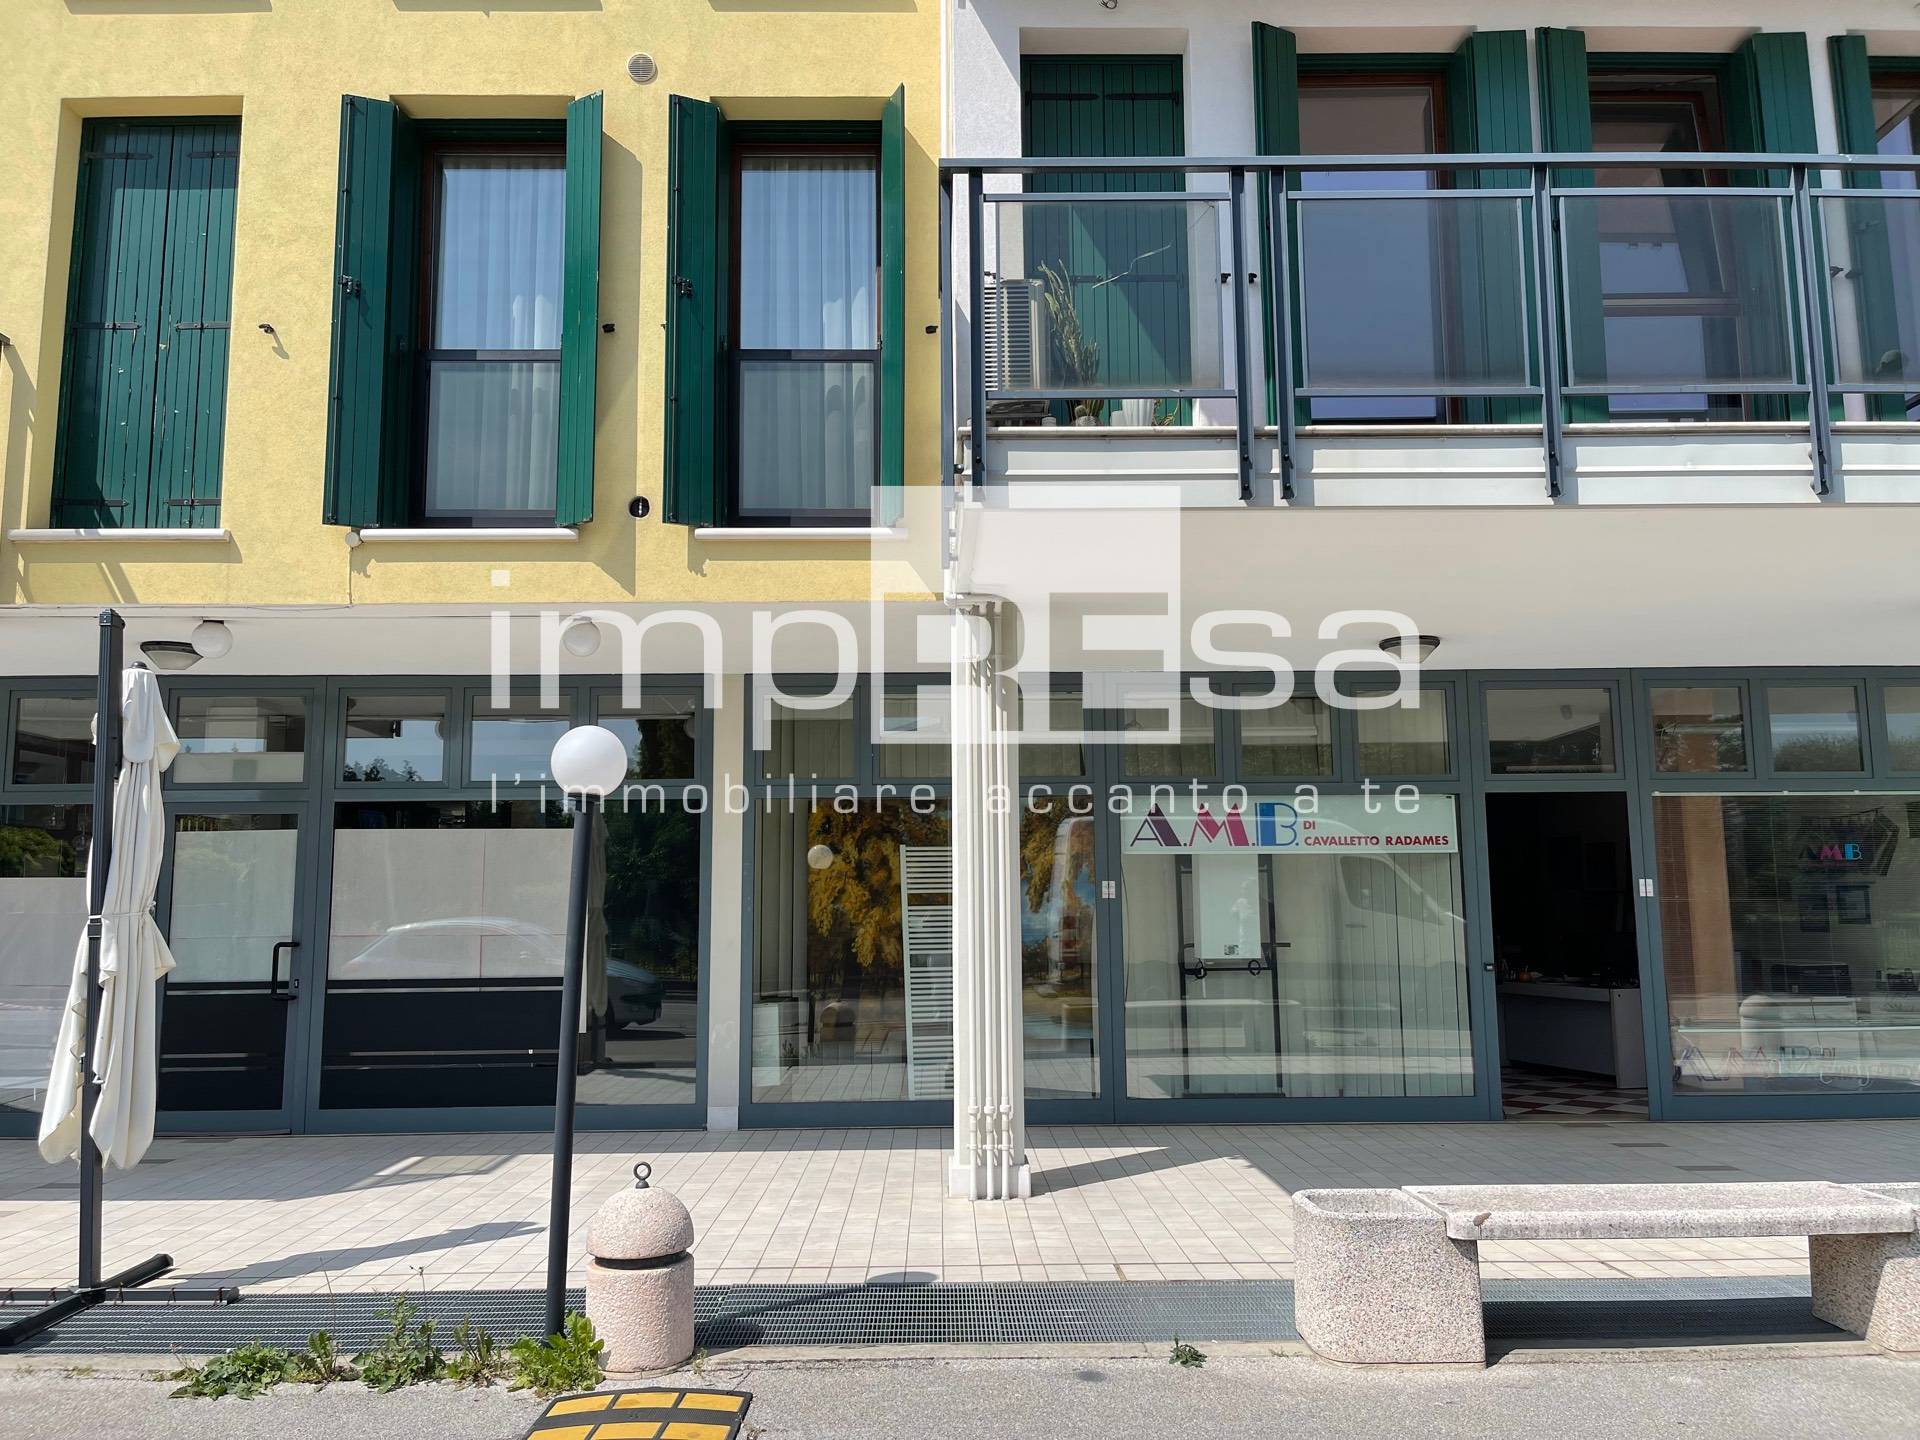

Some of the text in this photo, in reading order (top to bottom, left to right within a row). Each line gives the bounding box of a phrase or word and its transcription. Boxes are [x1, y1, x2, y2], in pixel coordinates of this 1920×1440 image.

[1130, 802, 1299, 847] A.M.B.
[1303, 820, 1316, 831] DI
[1304, 835, 1449, 846] CAVALLETTO RADAMES
